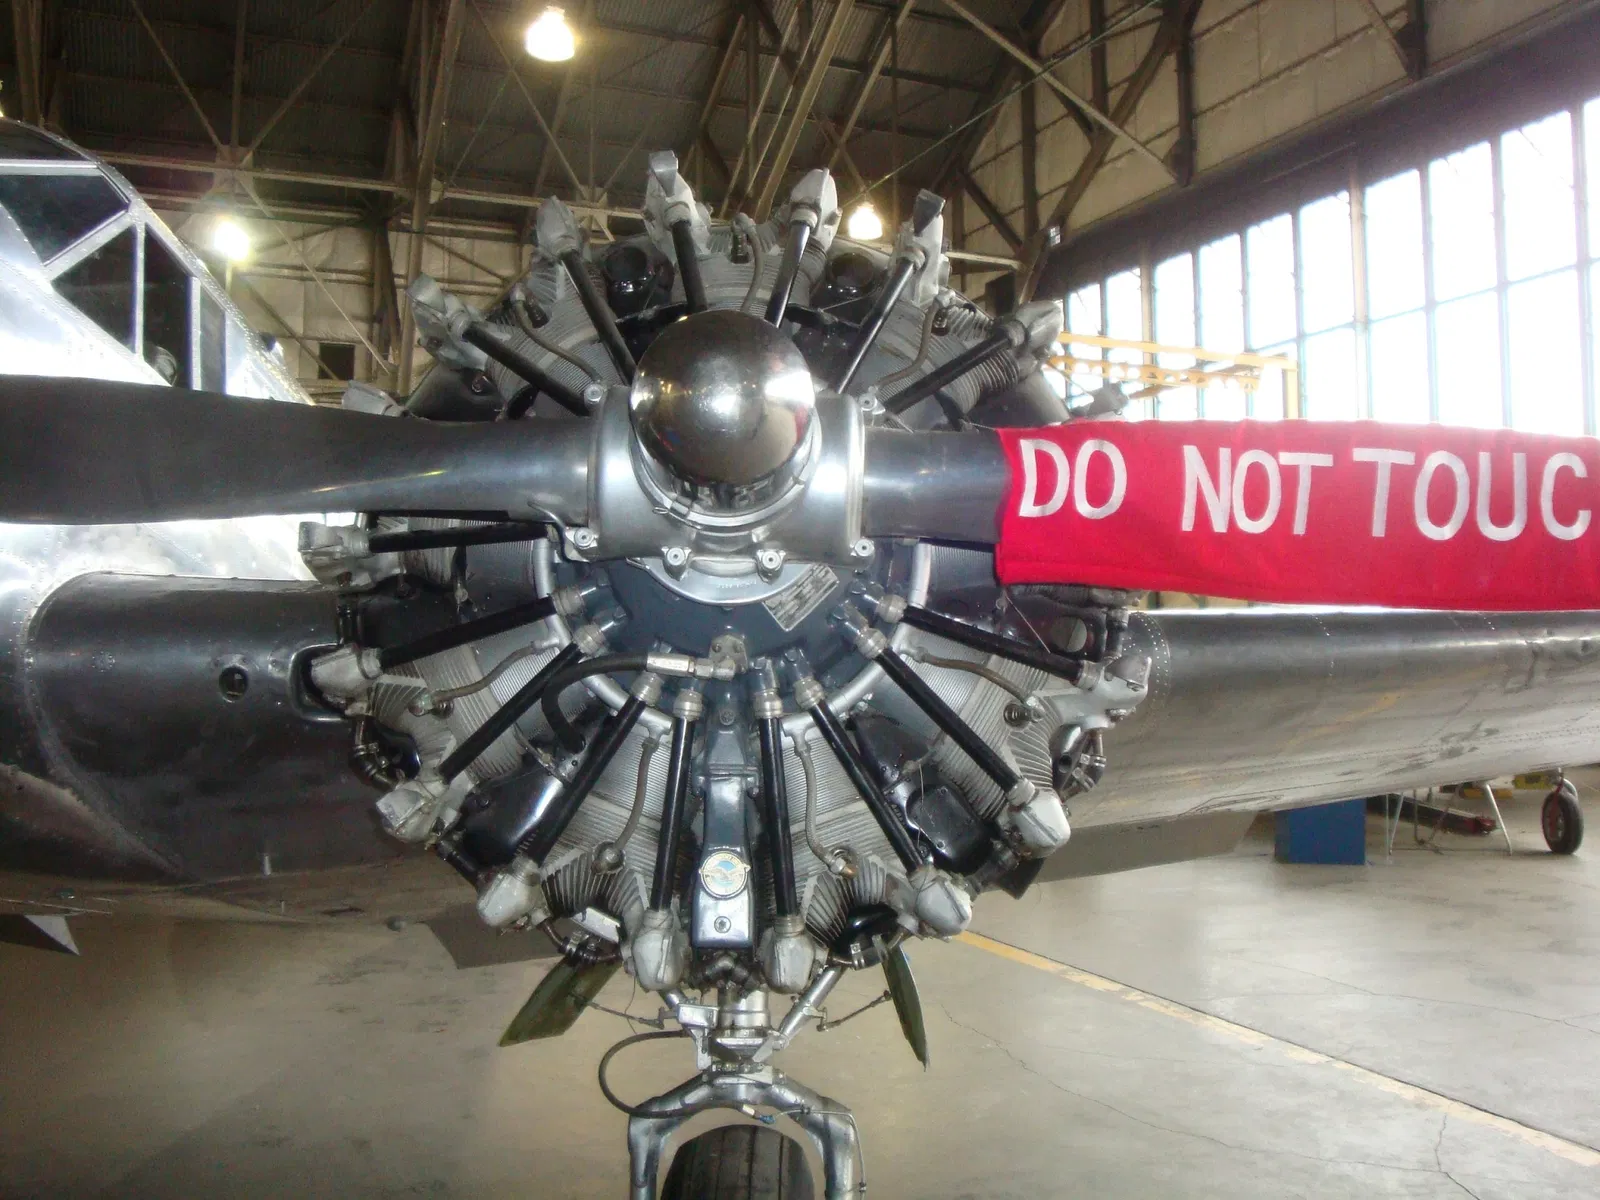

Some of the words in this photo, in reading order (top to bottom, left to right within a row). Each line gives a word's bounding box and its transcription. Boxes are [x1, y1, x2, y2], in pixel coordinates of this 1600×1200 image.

[1019, 438, 1127, 520] DO
[1181, 444, 1334, 536] NOT
[1352, 447, 1592, 541] TOUC
